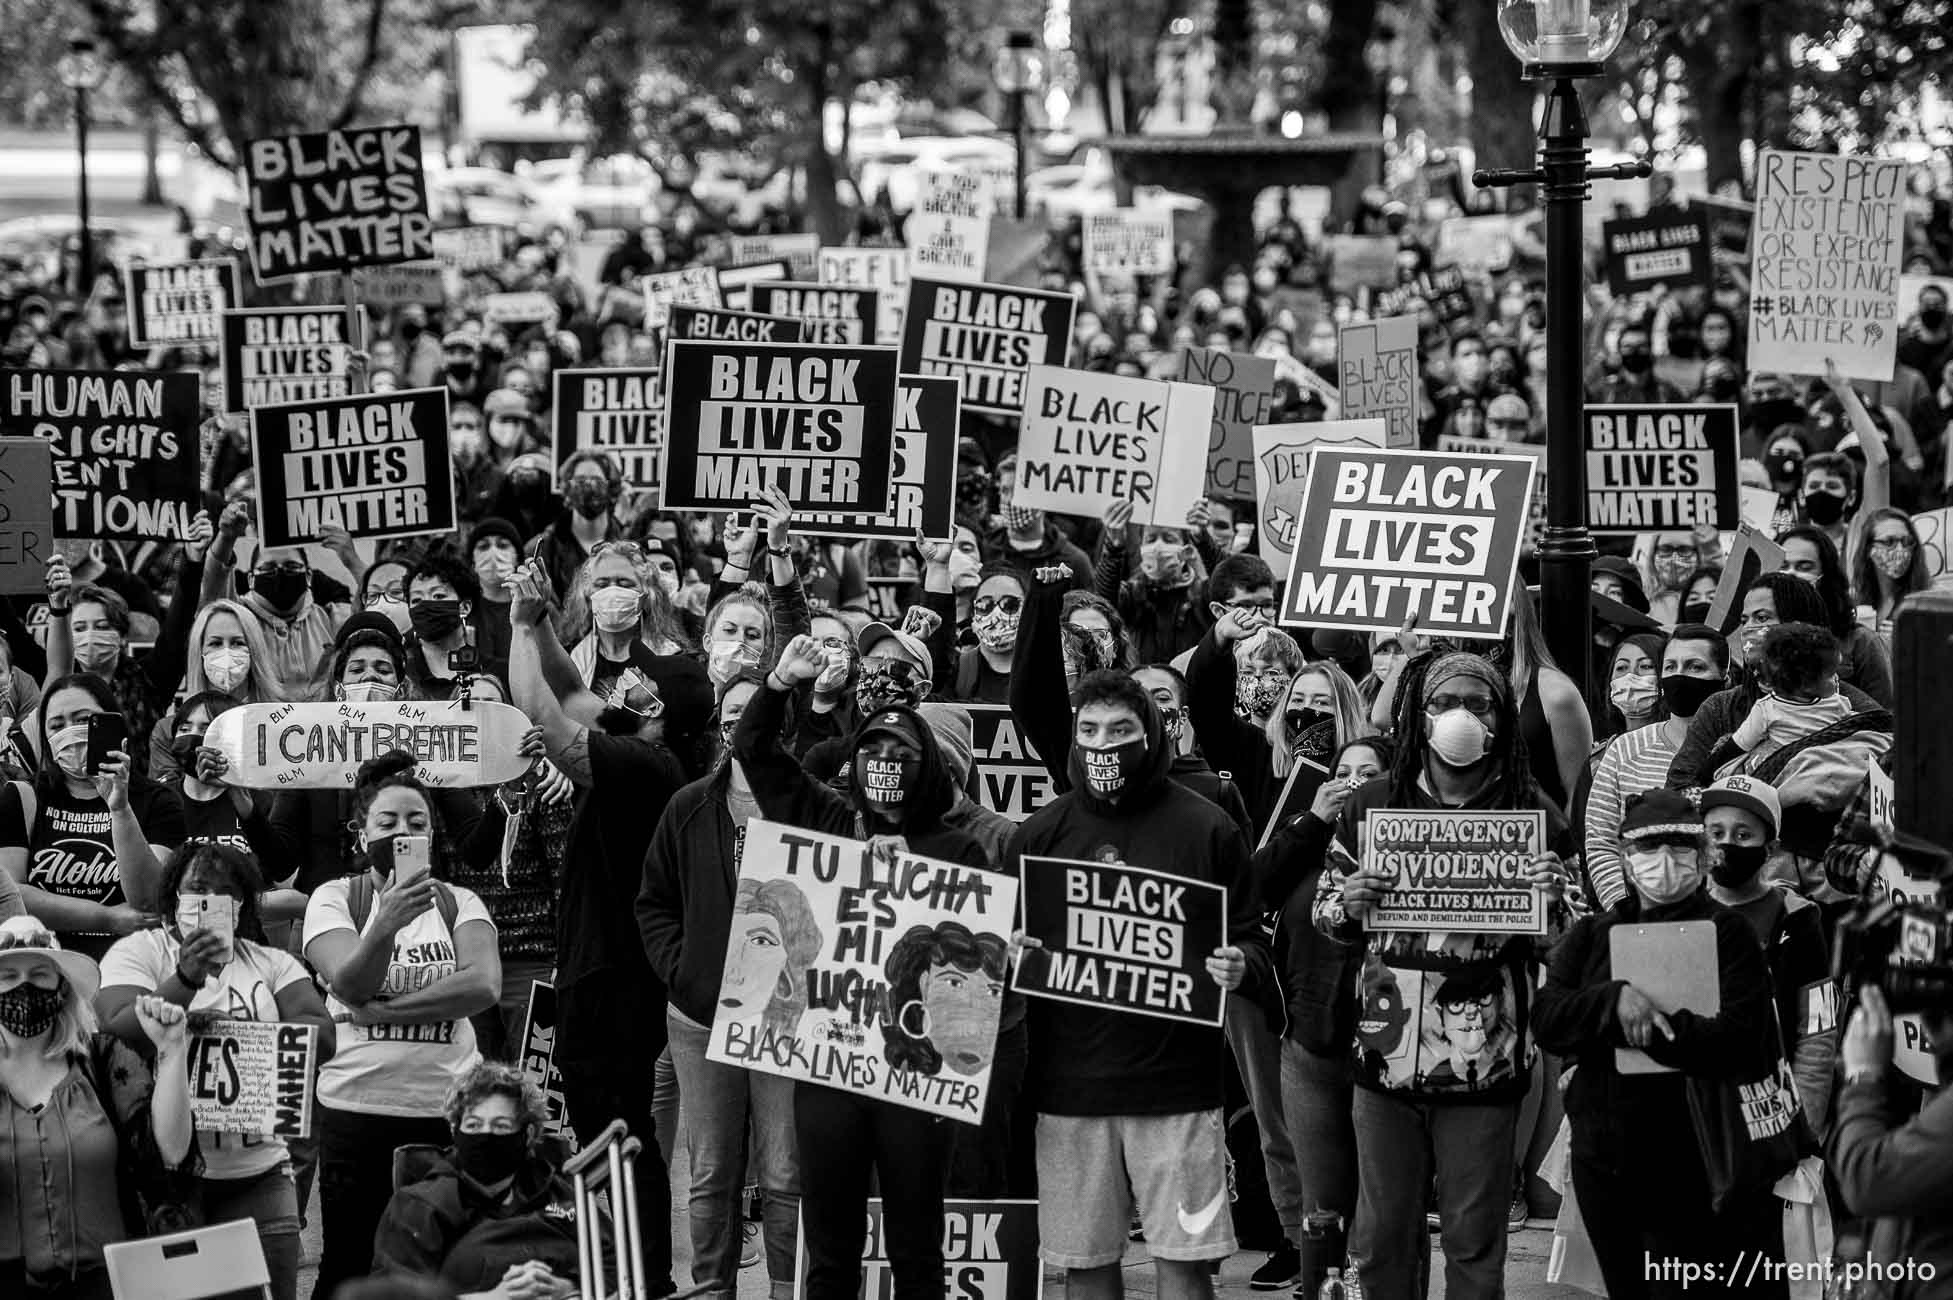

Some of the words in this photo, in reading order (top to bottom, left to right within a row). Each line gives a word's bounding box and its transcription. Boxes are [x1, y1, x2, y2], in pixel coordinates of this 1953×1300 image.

[250, 130, 416, 180] BLACK
[1766, 154, 1904, 200] RESPECT
[252, 175, 419, 225] LIVES
[1760, 198, 1896, 239] EXISTENCE
[260, 213, 434, 270] MATTER
[1761, 232, 1796, 258] OR
[1814, 232, 1895, 263] EXPECT
[1758, 256, 1896, 296] RESISTANCE
[769, 289, 860, 318] BLACK
[933, 287, 1048, 333] BLACK
[245, 314, 341, 345] BLACK
[693, 312, 775, 342] BLACK
[1756, 317, 1855, 345] MATTER
[256, 349, 331, 375] LIVES
[938, 325, 1031, 368] LIVES
[710, 355, 861, 402] BLACK
[1184, 348, 1235, 385] NO
[1344, 353, 1411, 387] BLACK
[11, 374, 163, 418] HUMAN
[243, 378, 346, 408] MATTER
[583, 377, 664, 410] BLAC
[1041, 387, 1161, 433] BLACK
[1345, 380, 1409, 408] LIVES
[288, 401, 417, 451] BLACK
[591, 414, 664, 444] LIVE
[719, 405, 843, 452] LIVES
[1054, 426, 1147, 463] LIVES
[1591, 414, 1708, 451] BLACK
[302, 446, 408, 493] LIVES
[694, 455, 861, 503] MATTER
[1023, 461, 1154, 504] MATTER
[1333, 461, 1504, 511] BLACK
[1603, 454, 1698, 488] LIVES
[288, 487, 429, 538] MATTER
[1588, 491, 1718, 527] MATTER
[1334, 518, 1479, 566] LIVES
[1295, 572, 1497, 625] MATTER
[269, 704, 295, 724] BLM
[338, 704, 366, 722] BLM
[398, 703, 426, 722] BLM
[257, 723, 267, 766] I
[1086, 751, 1120, 765] BLACK
[277, 767, 305, 785] BLM
[418, 767, 444, 786] BLM
[867, 760, 902, 774] BLACK
[869, 775, 899, 787] LIVES
[1089, 766, 1118, 778] LIVES
[45, 806, 60, 819] NO
[61, 809, 112, 824] TRADEMA
[52, 819, 67, 831] ON
[68, 821, 112, 833] CULTURE
[1375, 819, 1533, 847] COMPLACENCY
[28, 848, 121, 885] Aloha
[779, 834, 840, 883] TU
[860, 849, 992, 915] LUCHA
[1376, 853, 1401, 882] IS
[1406, 853, 1532, 884] VIOLENCE
[56, 886, 70, 894] Not
[72, 887, 86, 895] For
[87, 887, 102, 895] Sale
[836, 886, 896, 929] ES
[1066, 868, 1187, 922] BLACK
[1380, 893, 1426, 908] BLACK
[1430, 894, 1469, 908] LIVES
[1472, 895, 1529, 909] MATTER
[1077, 912, 1173, 960] LIVES
[1377, 913, 1409, 921] DEFUND
[1412, 913, 1429, 922] AND
[1488, 915, 1504, 923] THE
[1505, 915, 1533, 924] POLICE
[407, 940, 454, 963] SKIN
[832, 925, 882, 965] MI
[1046, 952, 1193, 1012] MATTER
[724, 1022, 809, 1069] BLACK
[810, 1044, 878, 1089] LIVES
[884, 1066, 979, 1112] MATTER
